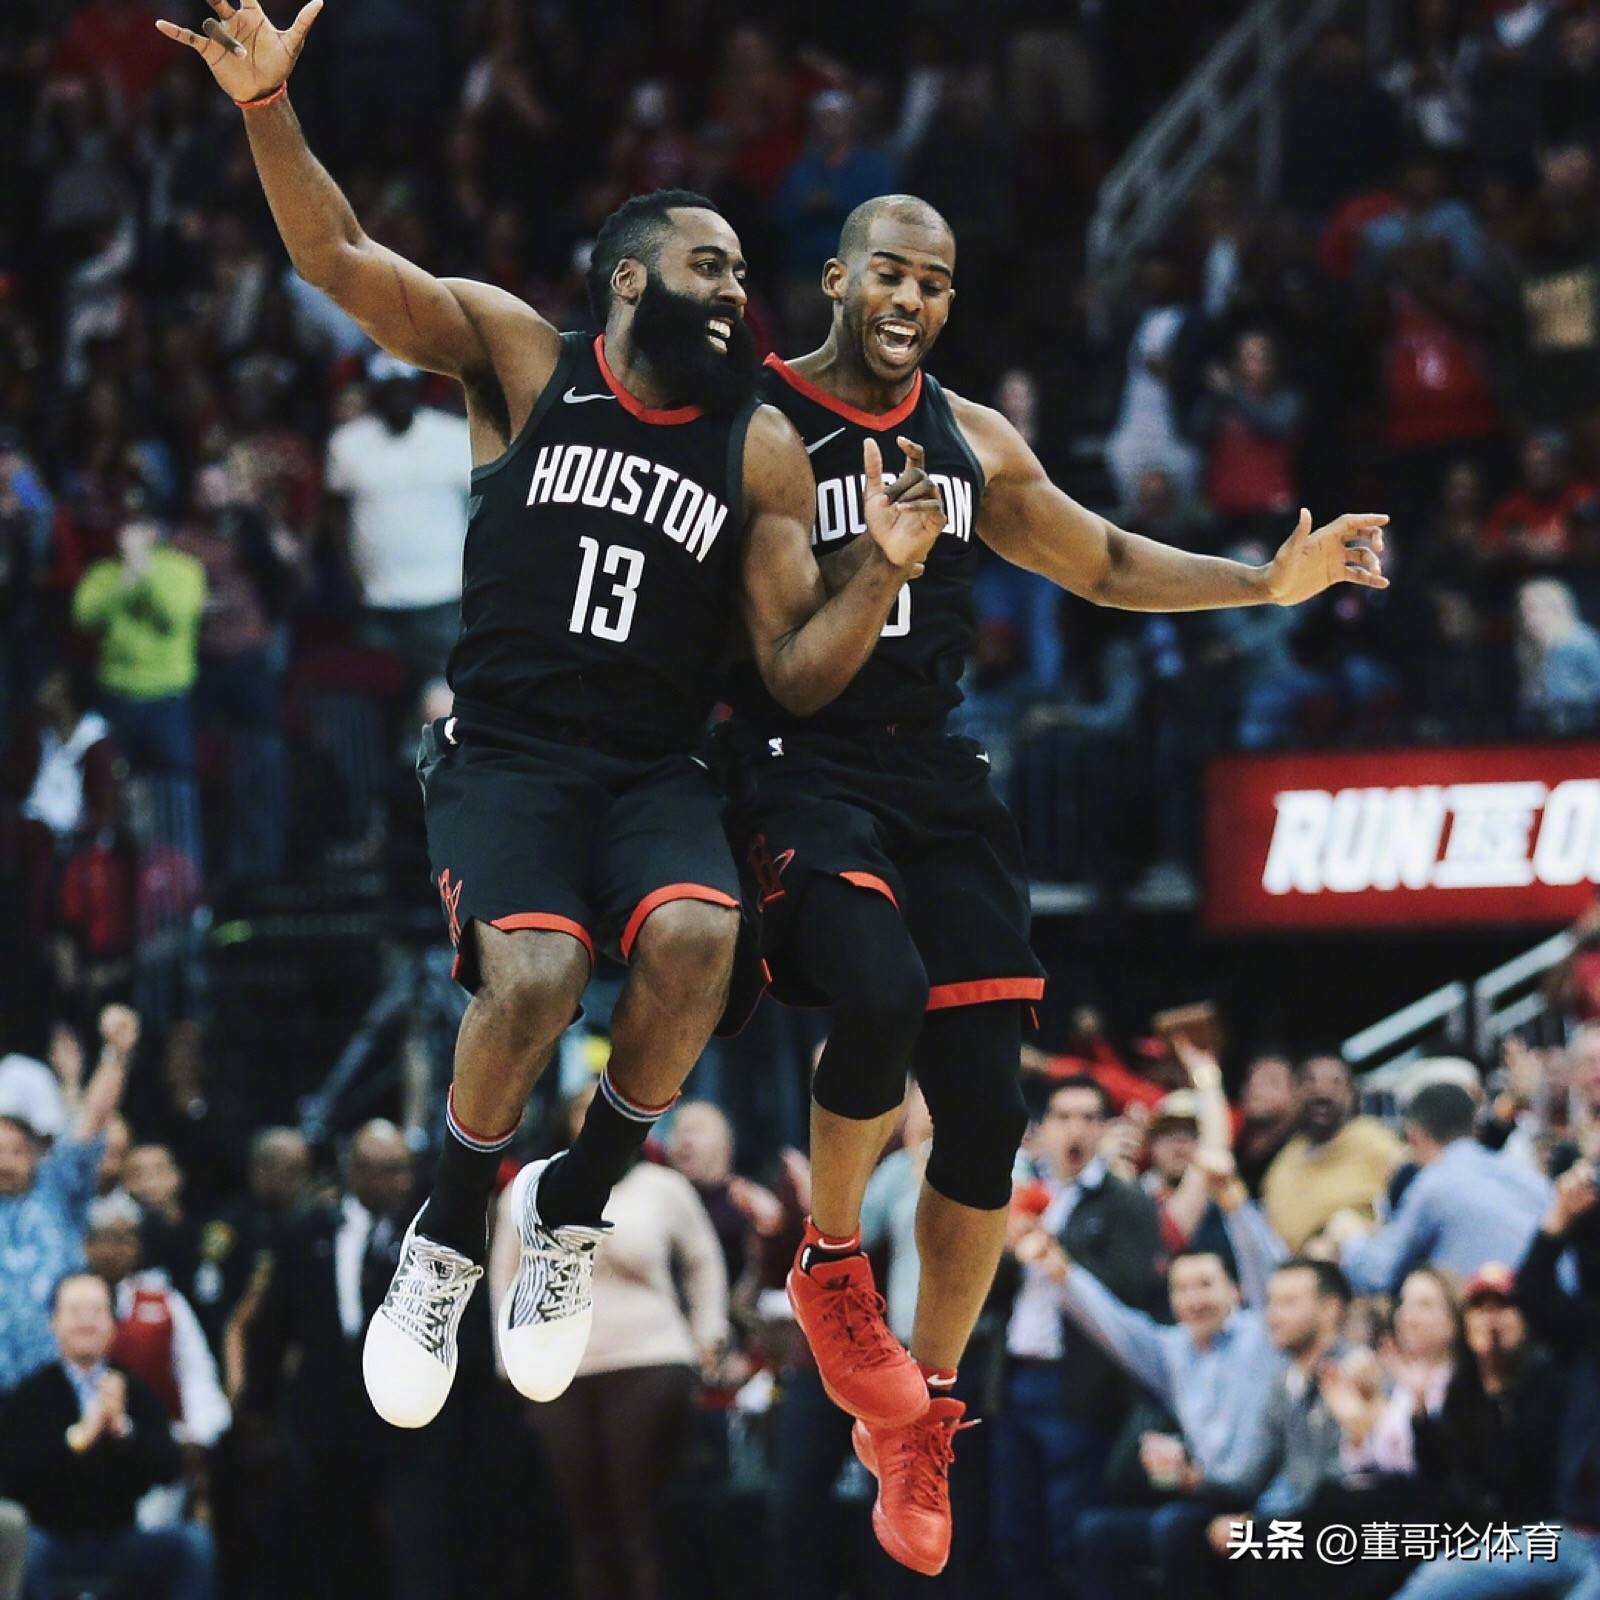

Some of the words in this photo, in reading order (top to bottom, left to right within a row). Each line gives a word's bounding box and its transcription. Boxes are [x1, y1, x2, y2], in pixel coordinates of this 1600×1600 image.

[527, 445, 728, 562] HOUSTON
[568, 536, 645, 643] 13
[1262, 785, 1444, 895] RUN
